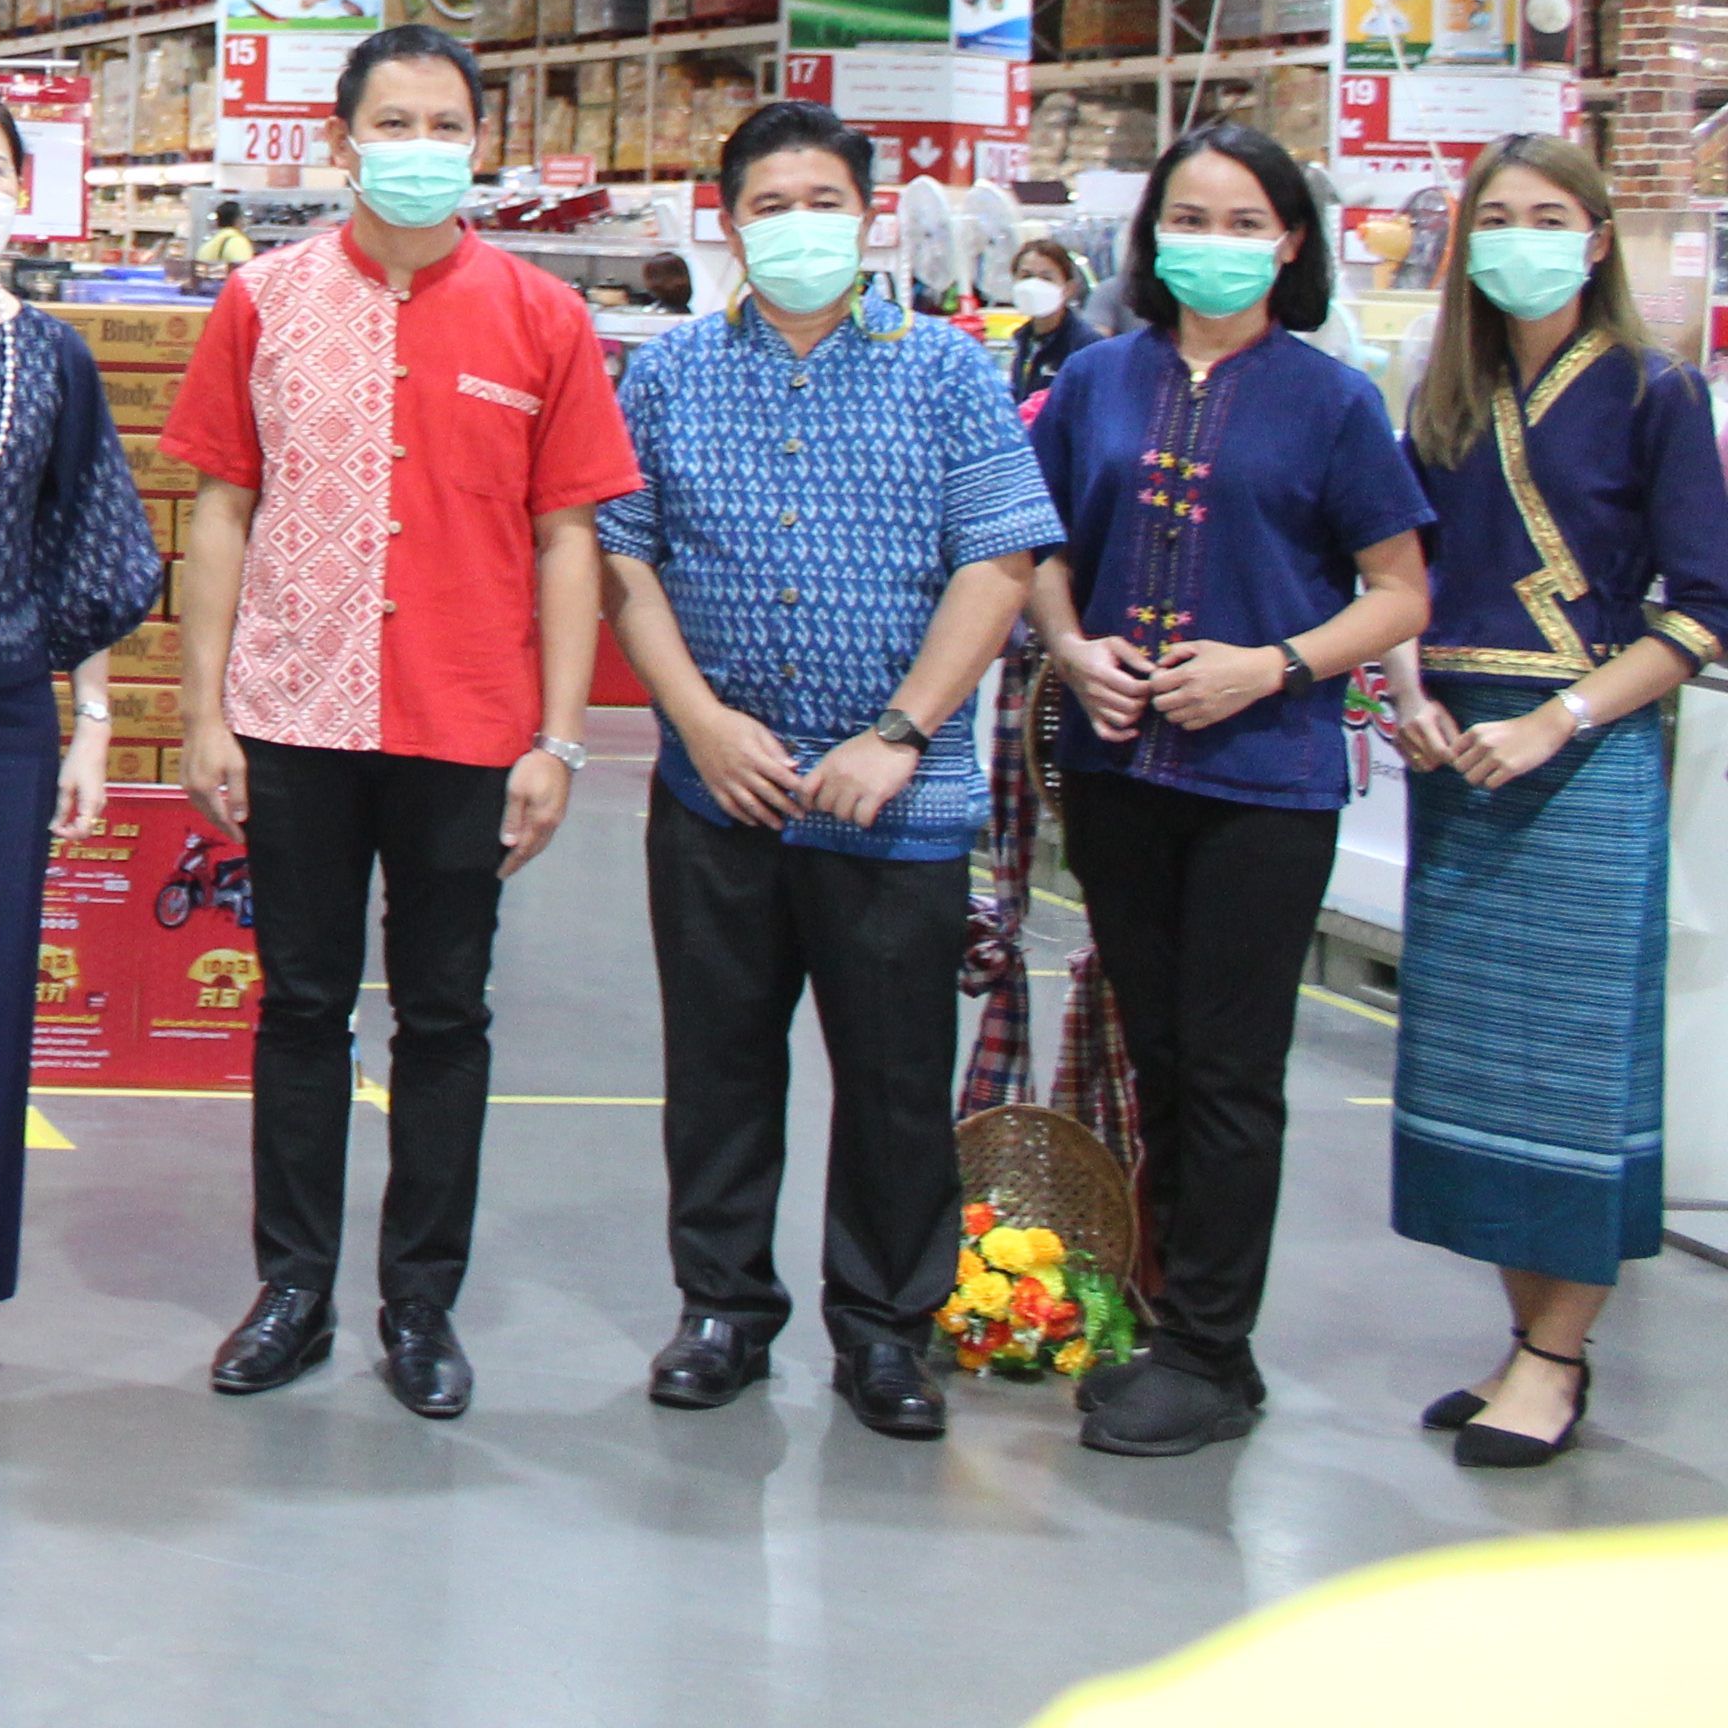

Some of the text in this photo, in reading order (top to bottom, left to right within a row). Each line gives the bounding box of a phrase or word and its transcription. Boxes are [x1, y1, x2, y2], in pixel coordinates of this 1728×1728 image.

[225, 39, 258, 66] 15
[788, 59, 820, 84] 17
[1341, 79, 1378, 105] 19
[245, 123, 305, 161] 280
